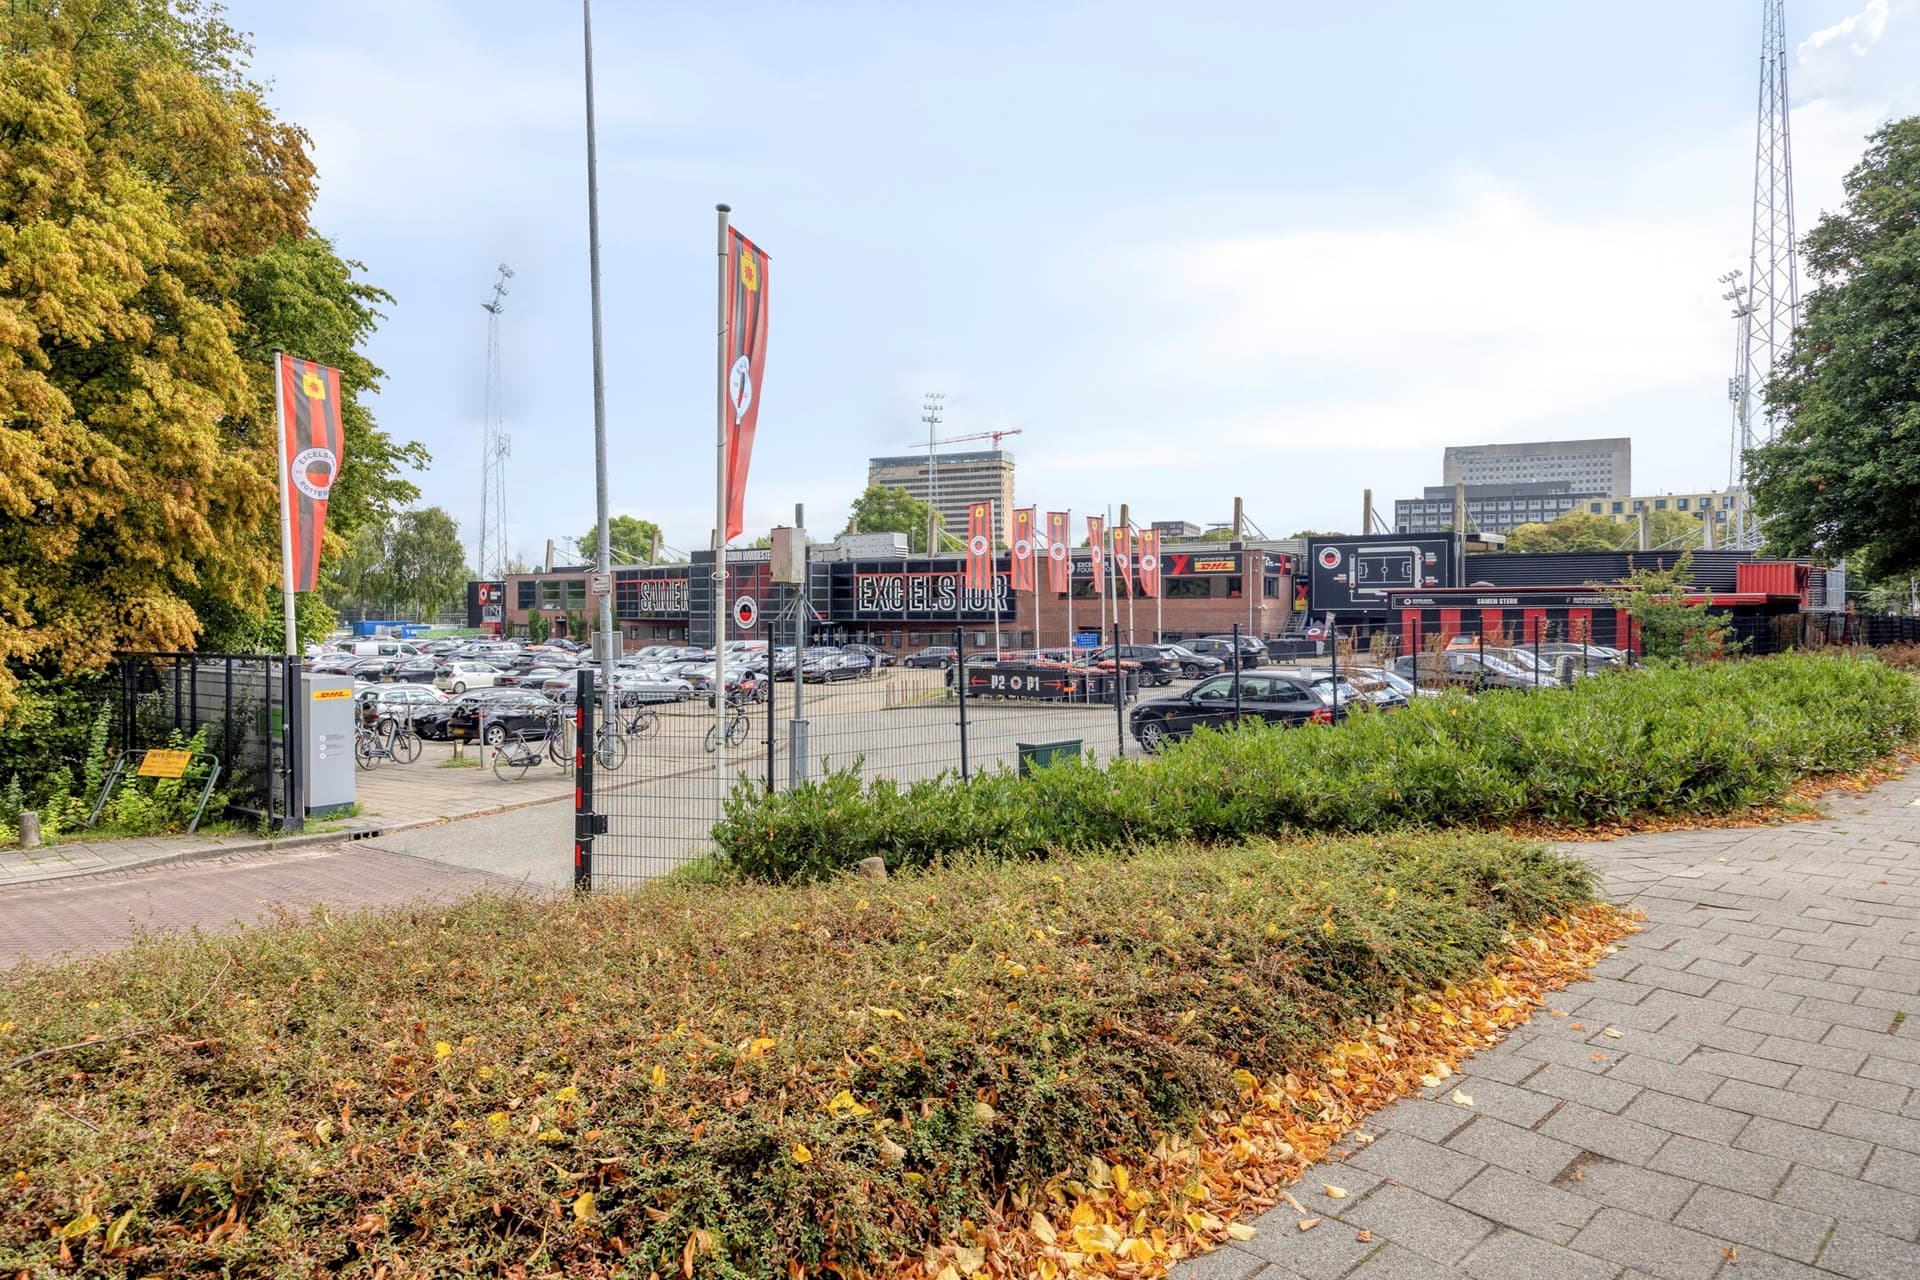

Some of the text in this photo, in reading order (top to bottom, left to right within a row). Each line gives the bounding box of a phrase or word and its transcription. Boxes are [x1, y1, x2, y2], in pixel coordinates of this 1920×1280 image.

[1200, 562, 1230, 570] DHL
[859, 575, 1008, 611] EXCELSIOR
[992, 675, 1040, 691] P2 P1
